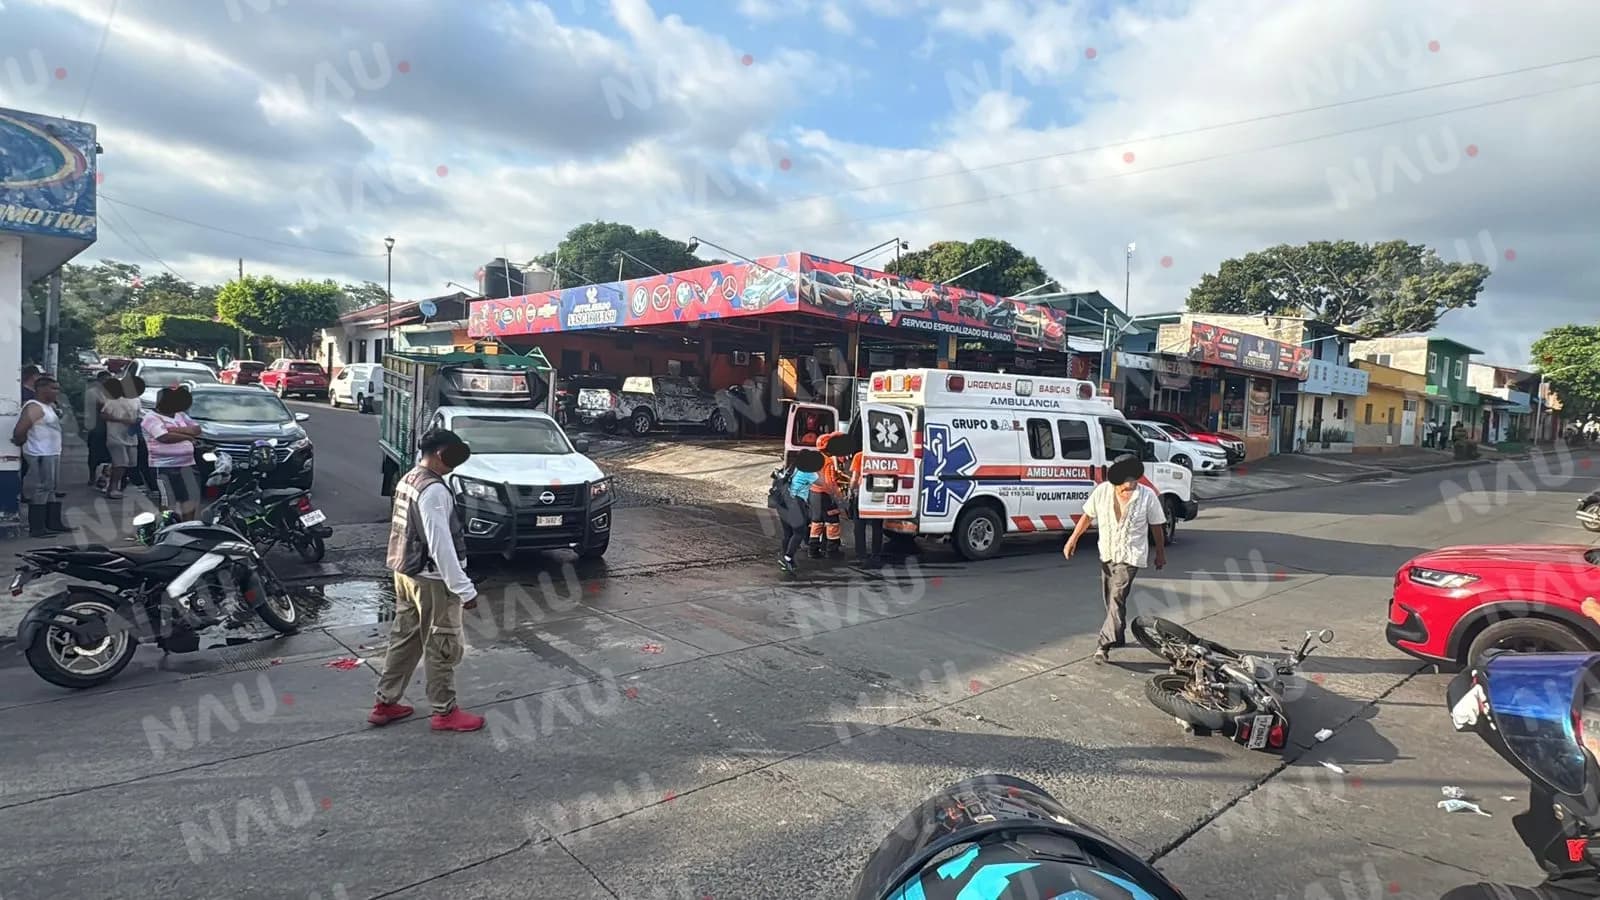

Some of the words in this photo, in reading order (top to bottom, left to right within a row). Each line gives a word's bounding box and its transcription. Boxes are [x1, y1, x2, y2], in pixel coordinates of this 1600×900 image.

[0, 203, 96, 234] MOTRIZ
[901, 317, 933, 330] SERVICIO
[933, 322, 981, 337] ESPECIALIZADO
[981, 330, 989, 339] DE
[989, 331, 1012, 342] LAVADO
[967, 380, 1012, 391] URGENCIAS
[1039, 384, 1071, 394] BASICAS
[990, 396, 1061, 409] AMBULANCIA
[952, 418, 988, 431] GRUPO
[863, 459, 899, 471] ANCIA
[1026, 467, 1087, 479] AMBULANCIA
[886, 494, 911, 506] 911
[1036, 491, 1089, 502] VOLUNTARIOS
